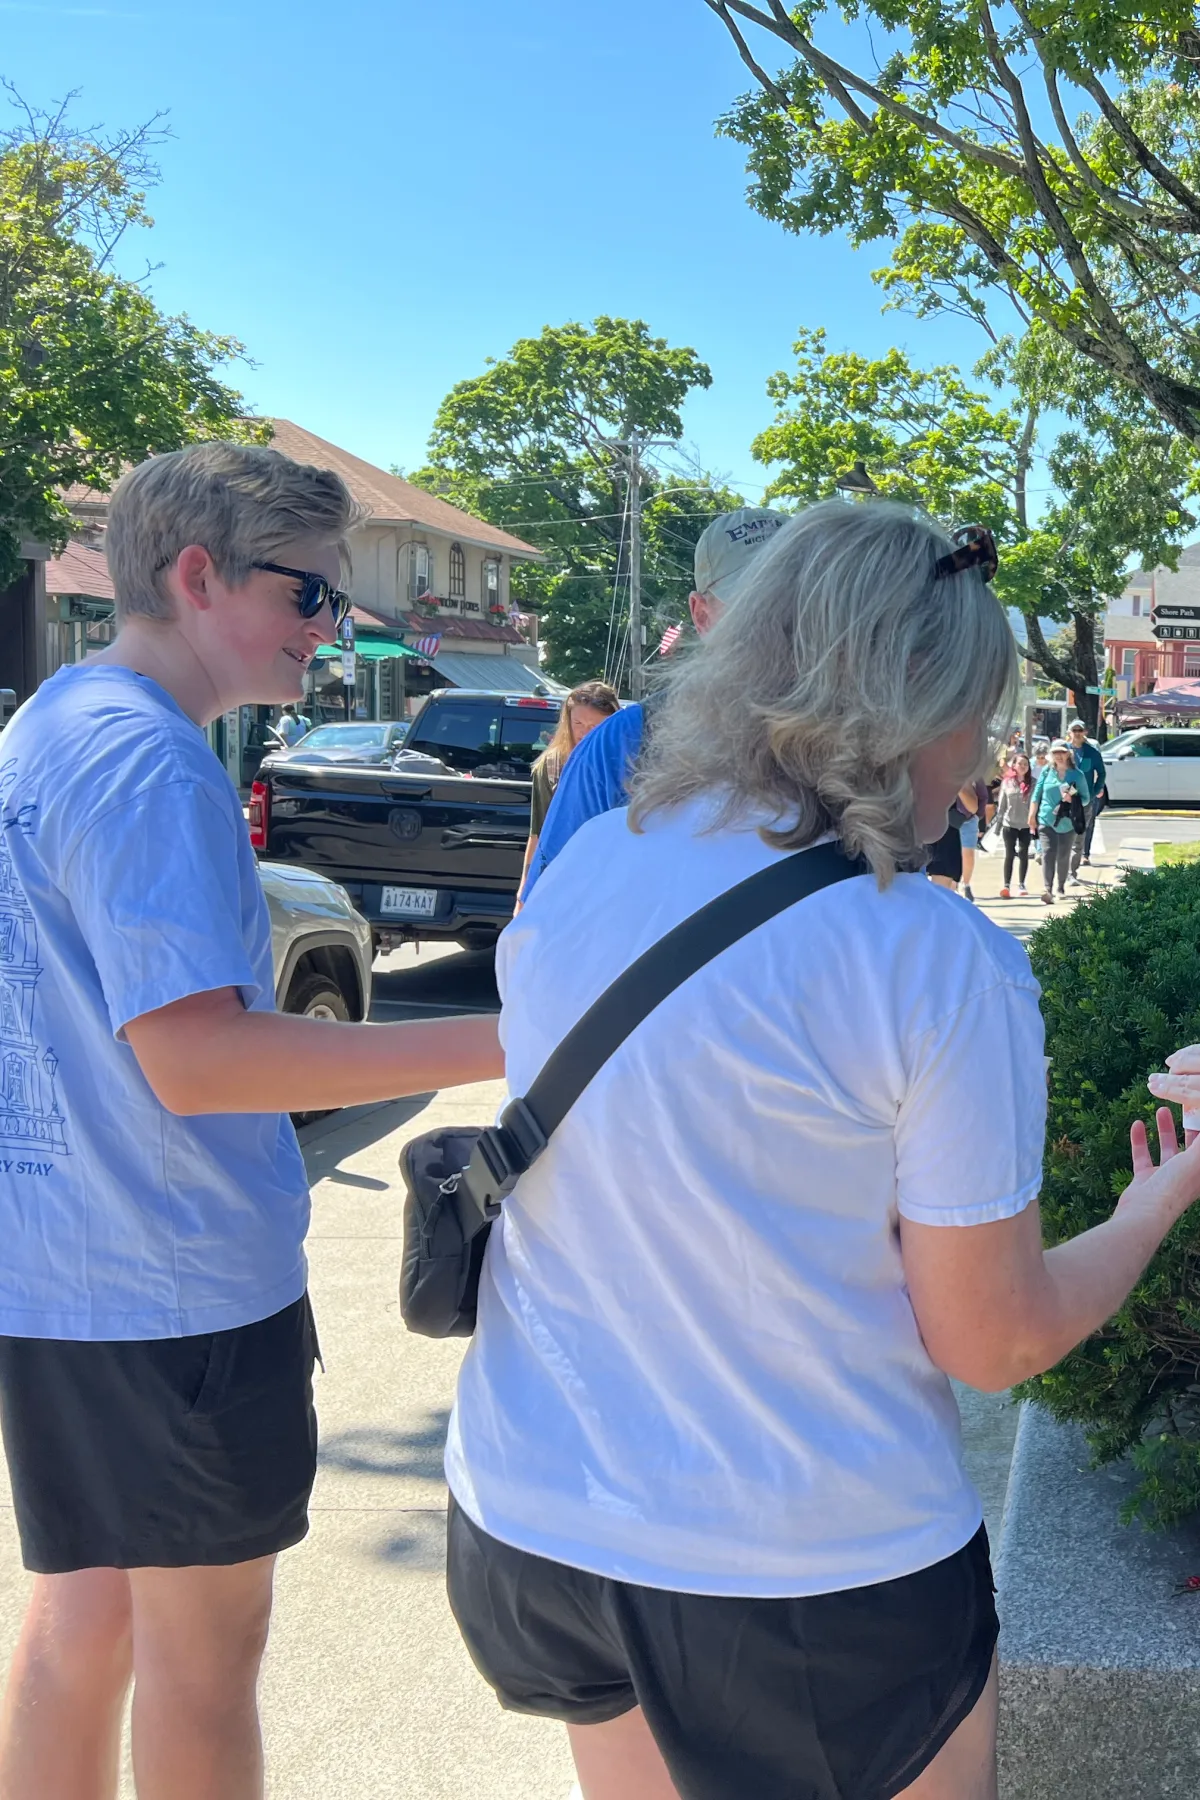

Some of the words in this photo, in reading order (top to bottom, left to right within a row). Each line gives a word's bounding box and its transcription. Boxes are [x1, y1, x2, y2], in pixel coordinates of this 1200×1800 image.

[1160, 608, 1179, 616] Shore
[1179, 609, 1195, 617] Path
[345, 618, 353, 637] H
[16, 1161, 54, 1176] STAY
